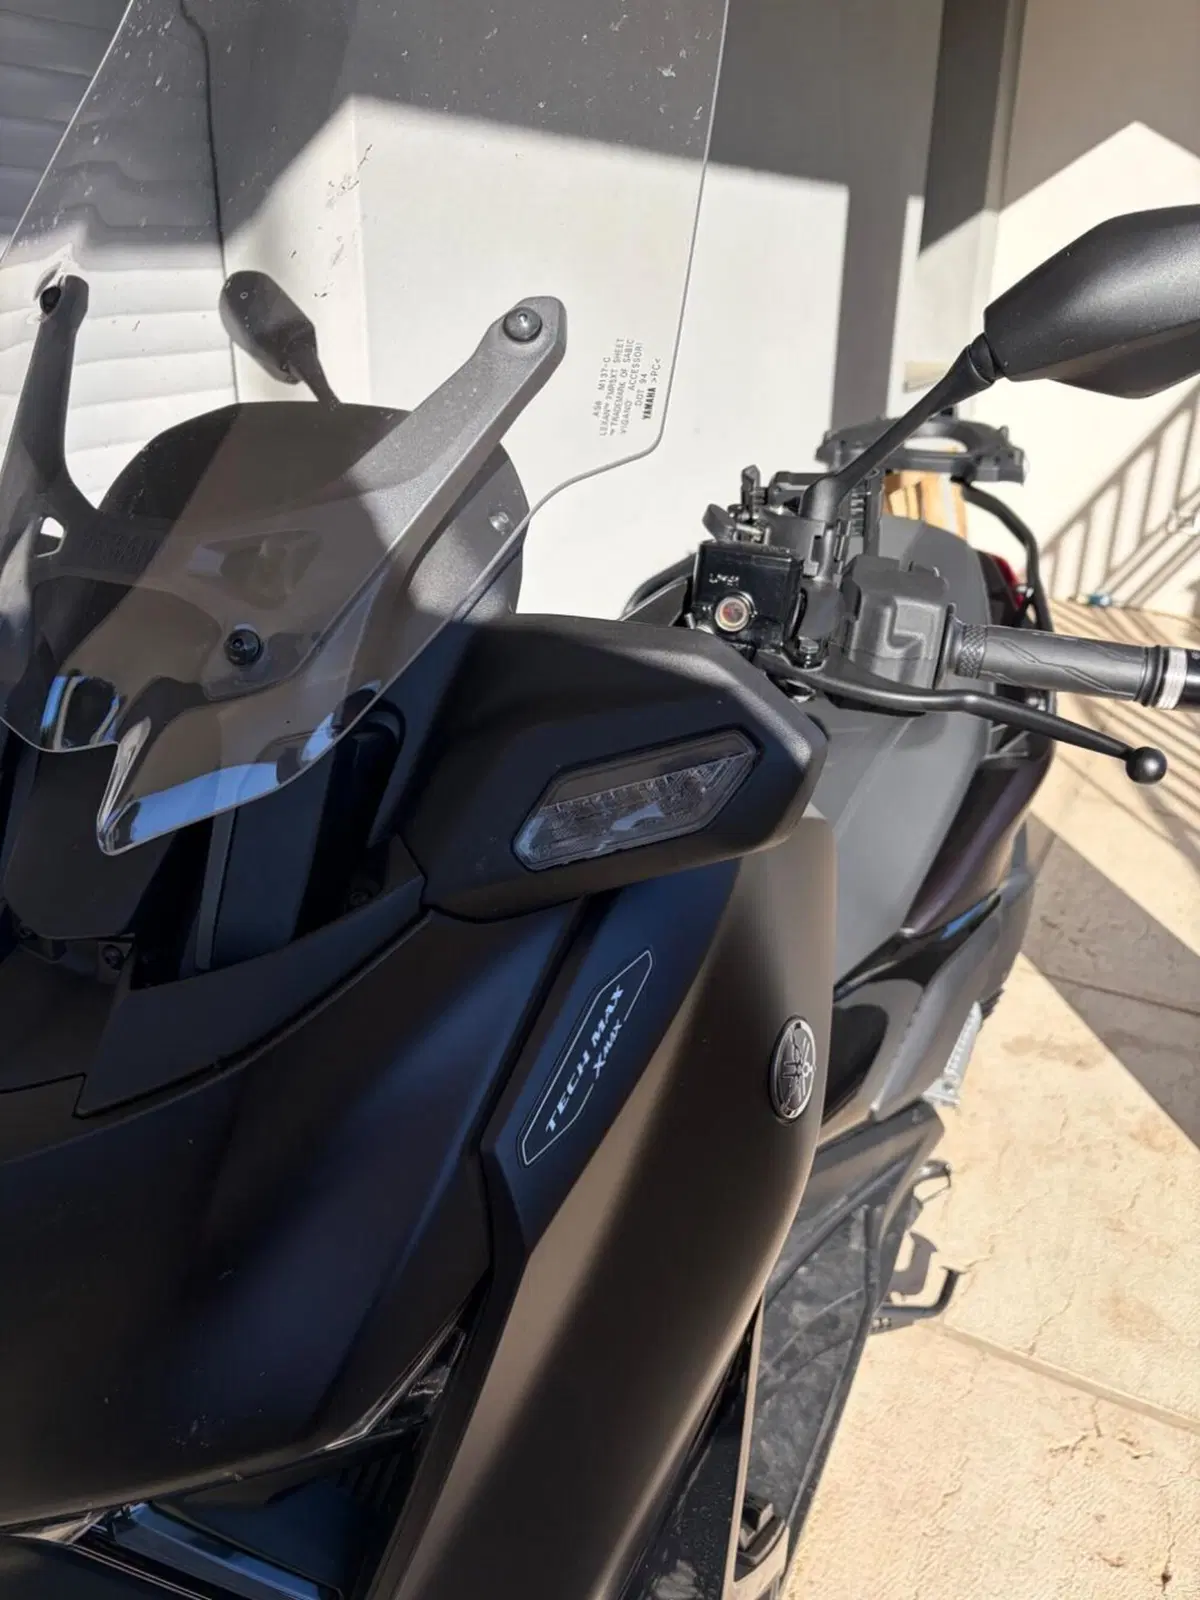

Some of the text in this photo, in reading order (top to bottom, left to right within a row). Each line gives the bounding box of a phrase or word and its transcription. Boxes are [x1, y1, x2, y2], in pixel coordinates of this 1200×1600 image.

[613, 338, 625, 363] SHEET
[610, 381, 626, 426] TRADEMARK
[620, 367, 628, 378] OF
[634, 373, 648, 406] DOT 94
[641, 387, 656, 420] YAMAHA
[545, 984, 624, 1132] TECH MAX
[593, 1018, 623, 1080] XMAX
